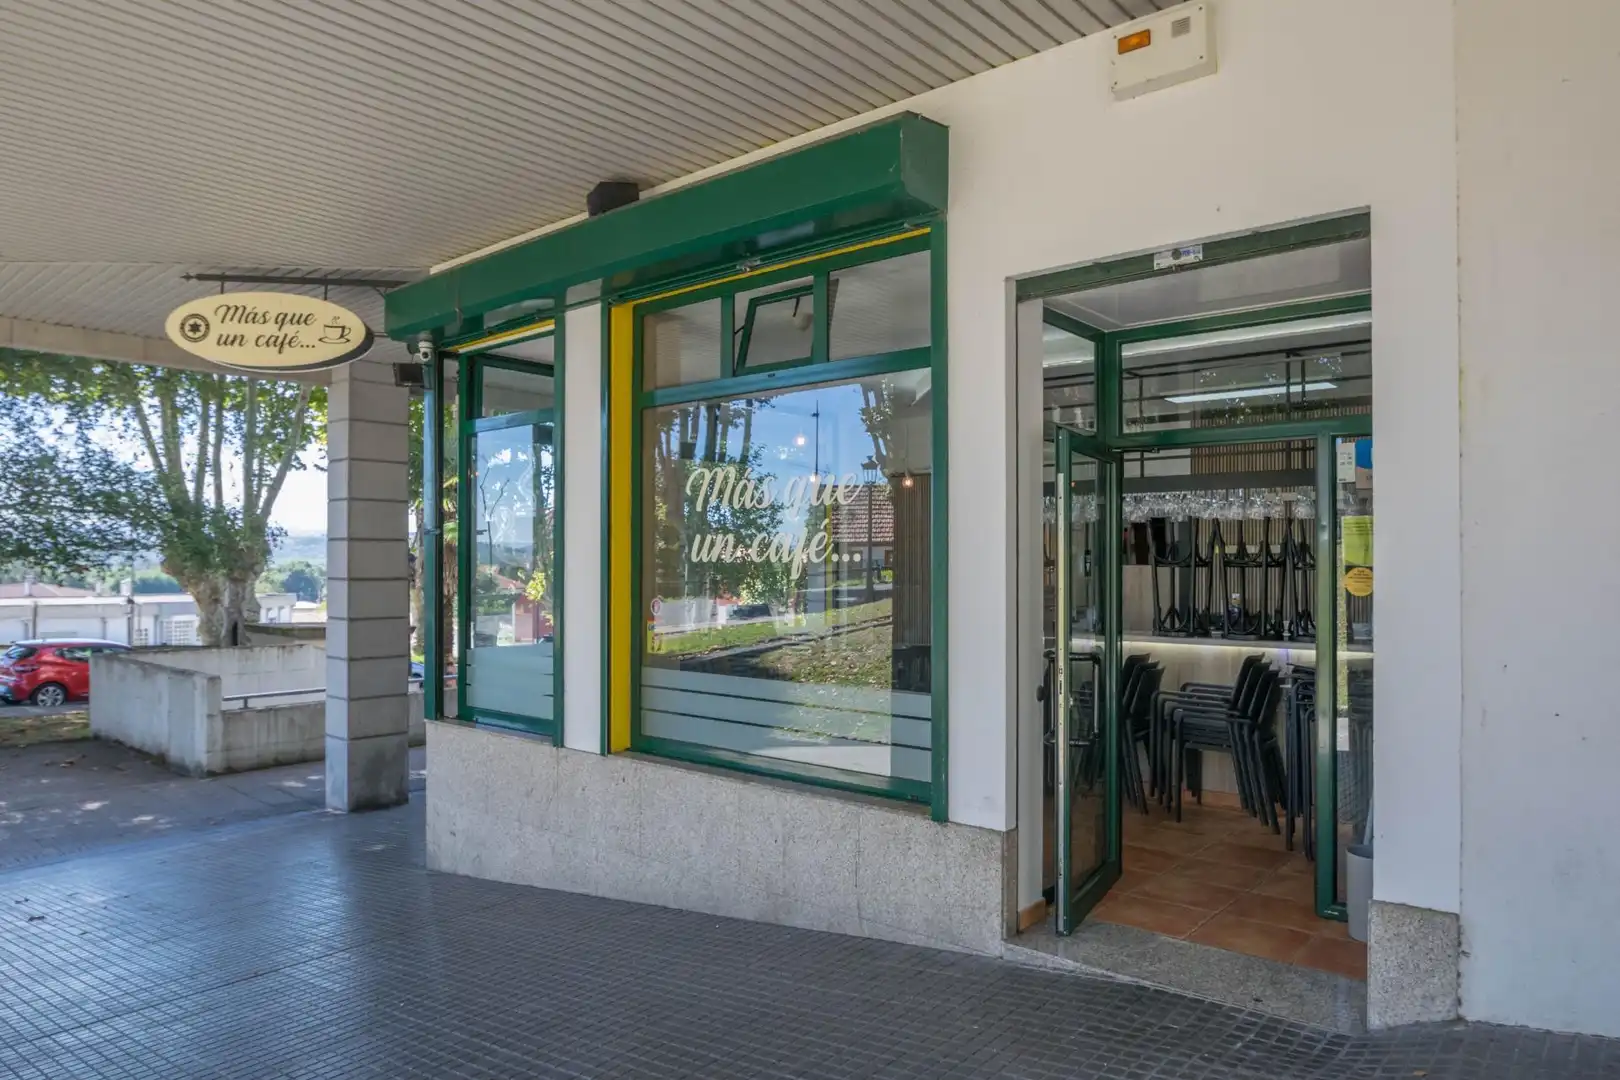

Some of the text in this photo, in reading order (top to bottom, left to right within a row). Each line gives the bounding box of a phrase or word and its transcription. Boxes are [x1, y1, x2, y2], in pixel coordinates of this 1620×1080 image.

[214, 304, 317, 332] Más que
[215, 332, 248, 347] un
[685, 466, 862, 521] Más que
[690, 533, 745, 564] un
